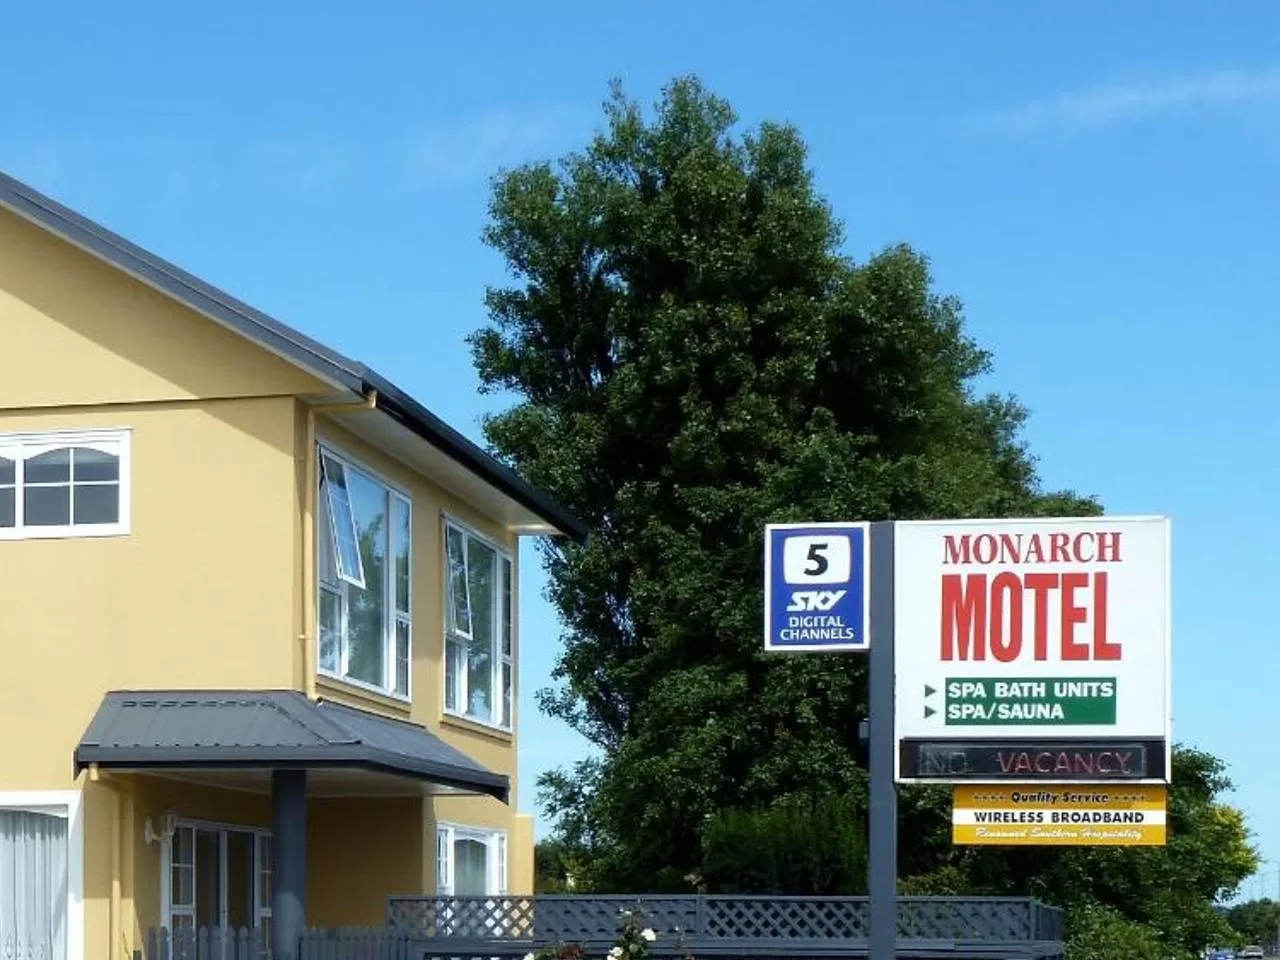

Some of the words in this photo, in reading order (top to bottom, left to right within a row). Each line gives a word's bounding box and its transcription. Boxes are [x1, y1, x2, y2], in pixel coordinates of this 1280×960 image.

[941, 531, 1123, 565] MONARCH
[803, 543, 828, 576] 5
[786, 589, 847, 612] SKY
[789, 615, 845, 627] DIGITAL
[939, 571, 1123, 663] MOTEL
[780, 627, 854, 641] CHANNELS
[947, 681, 988, 699] SPA
[994, 681, 1047, 699] BATH
[1053, 681, 1115, 698] UNITS
[947, 702, 1065, 721] SPA/SAUNA
[996, 750, 1134, 775] VACANCY
[1011, 791, 1058, 804] Quality
[1062, 791, 1109, 803] Service
[974, 811, 1045, 823] WIRELESS
[1051, 811, 1145, 823] BROADBAND
